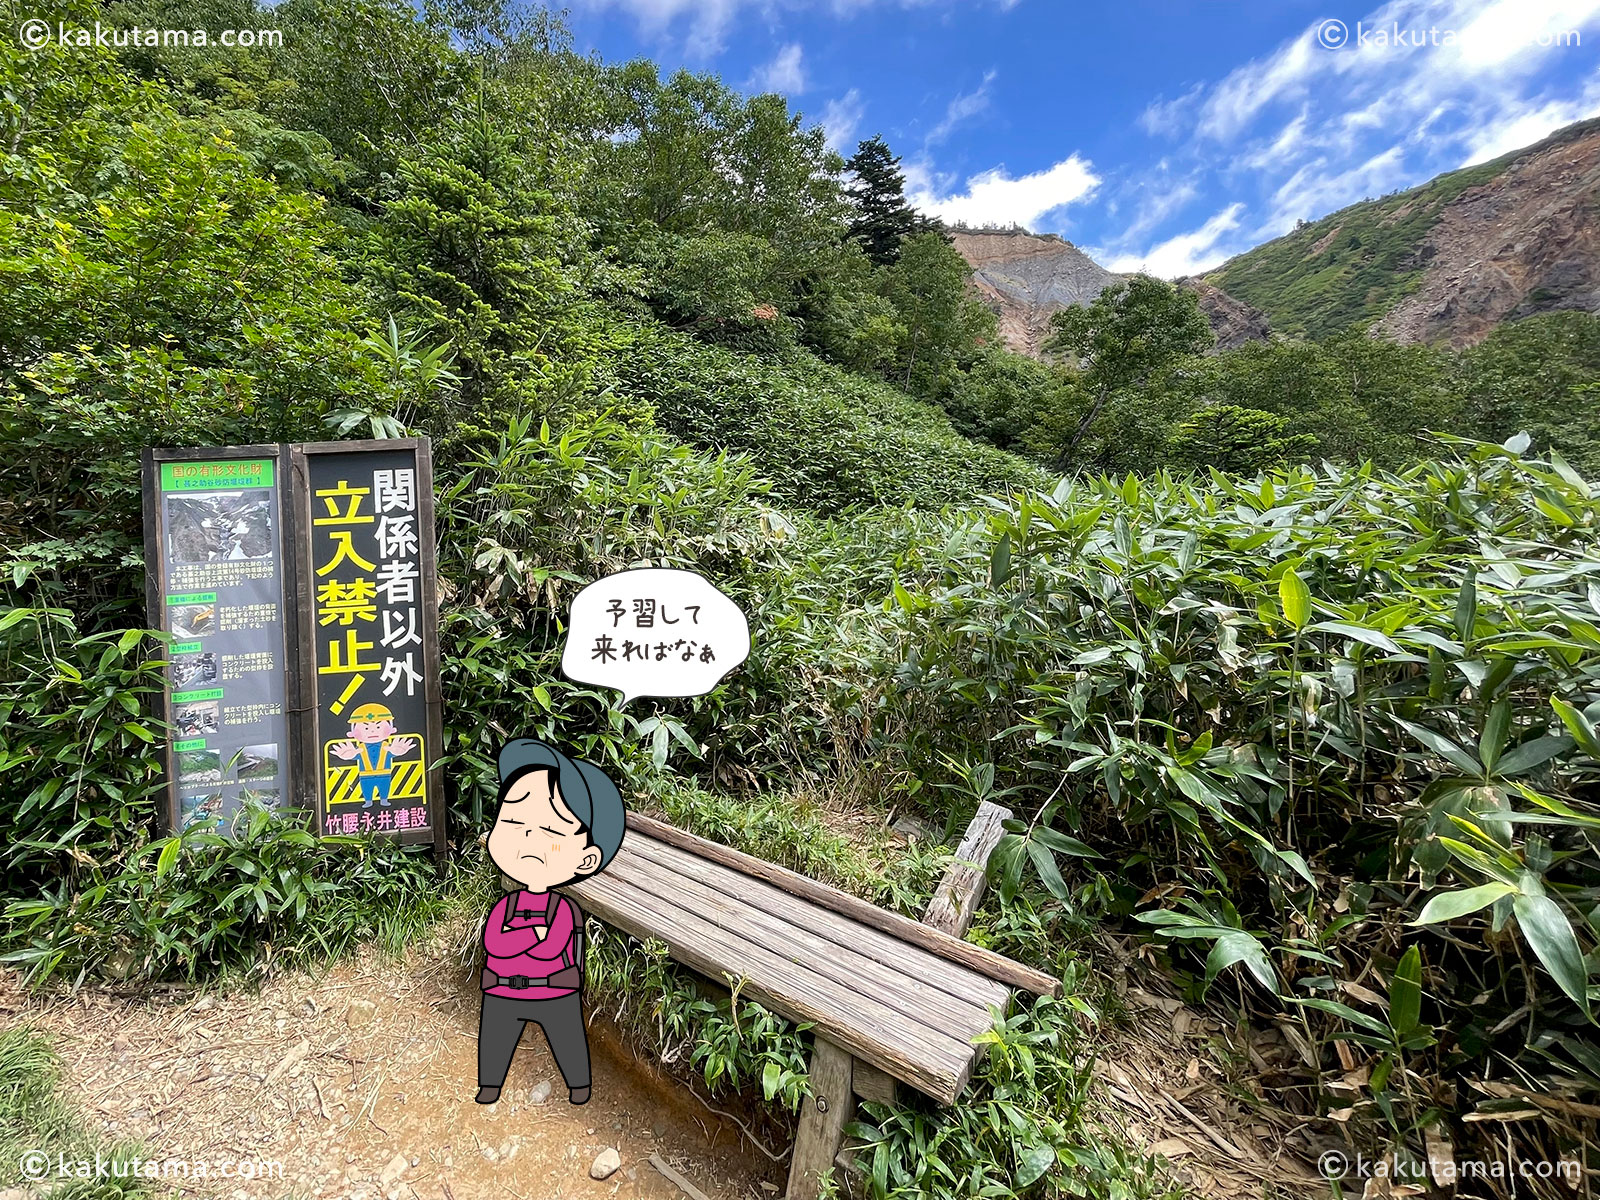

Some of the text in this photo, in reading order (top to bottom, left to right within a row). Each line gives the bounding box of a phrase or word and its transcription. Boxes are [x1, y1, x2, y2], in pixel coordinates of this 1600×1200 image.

[172, 463, 262, 478] 国の有形文化財
[373, 468, 424, 696] 関係者以外
[325, 807, 427, 835] 竹腰永井建設
